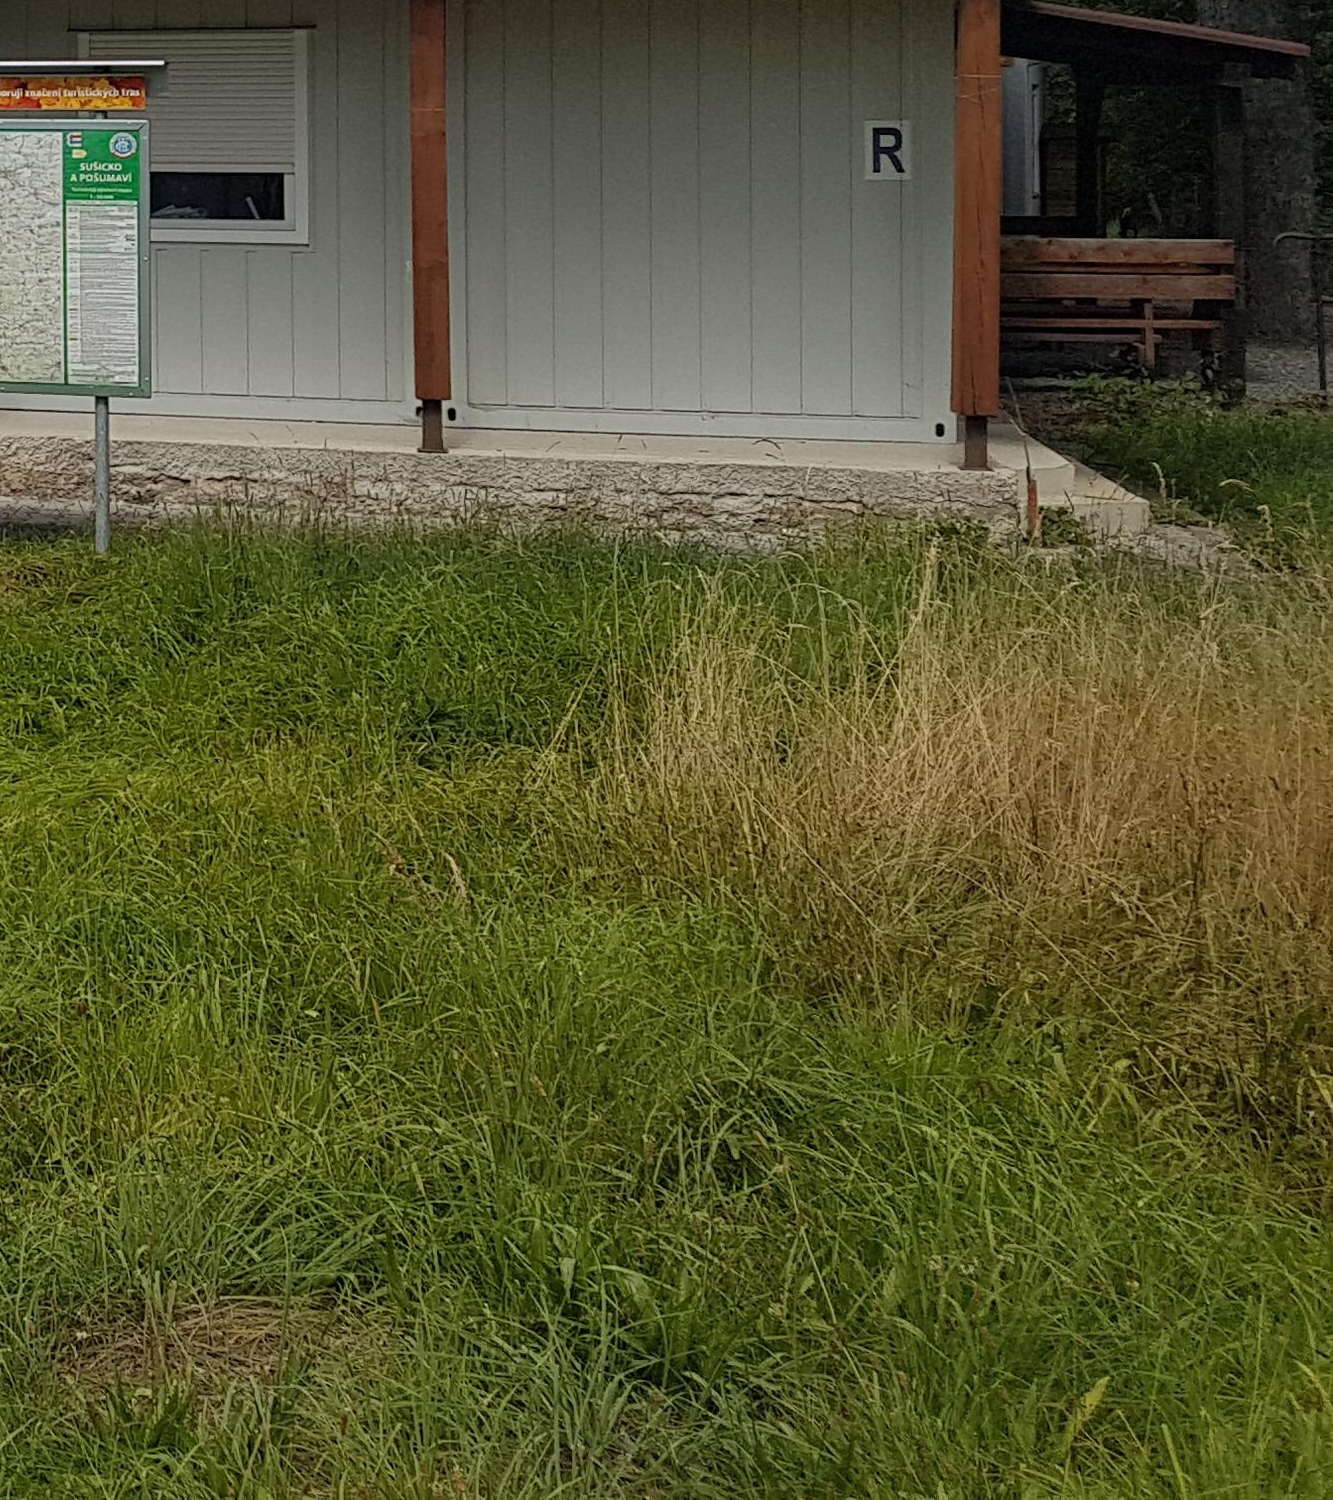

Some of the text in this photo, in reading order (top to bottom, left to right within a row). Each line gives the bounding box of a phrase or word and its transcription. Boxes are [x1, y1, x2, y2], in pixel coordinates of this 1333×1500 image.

[25, 87, 62, 98] značení
[63, 87, 119, 98] turistických
[121, 87, 141, 97] tras
[872, 127, 906, 173] R
[79, 161, 122, 171] SUŠICKO
[69, 173, 132, 183] A POŠUMAVÍ
